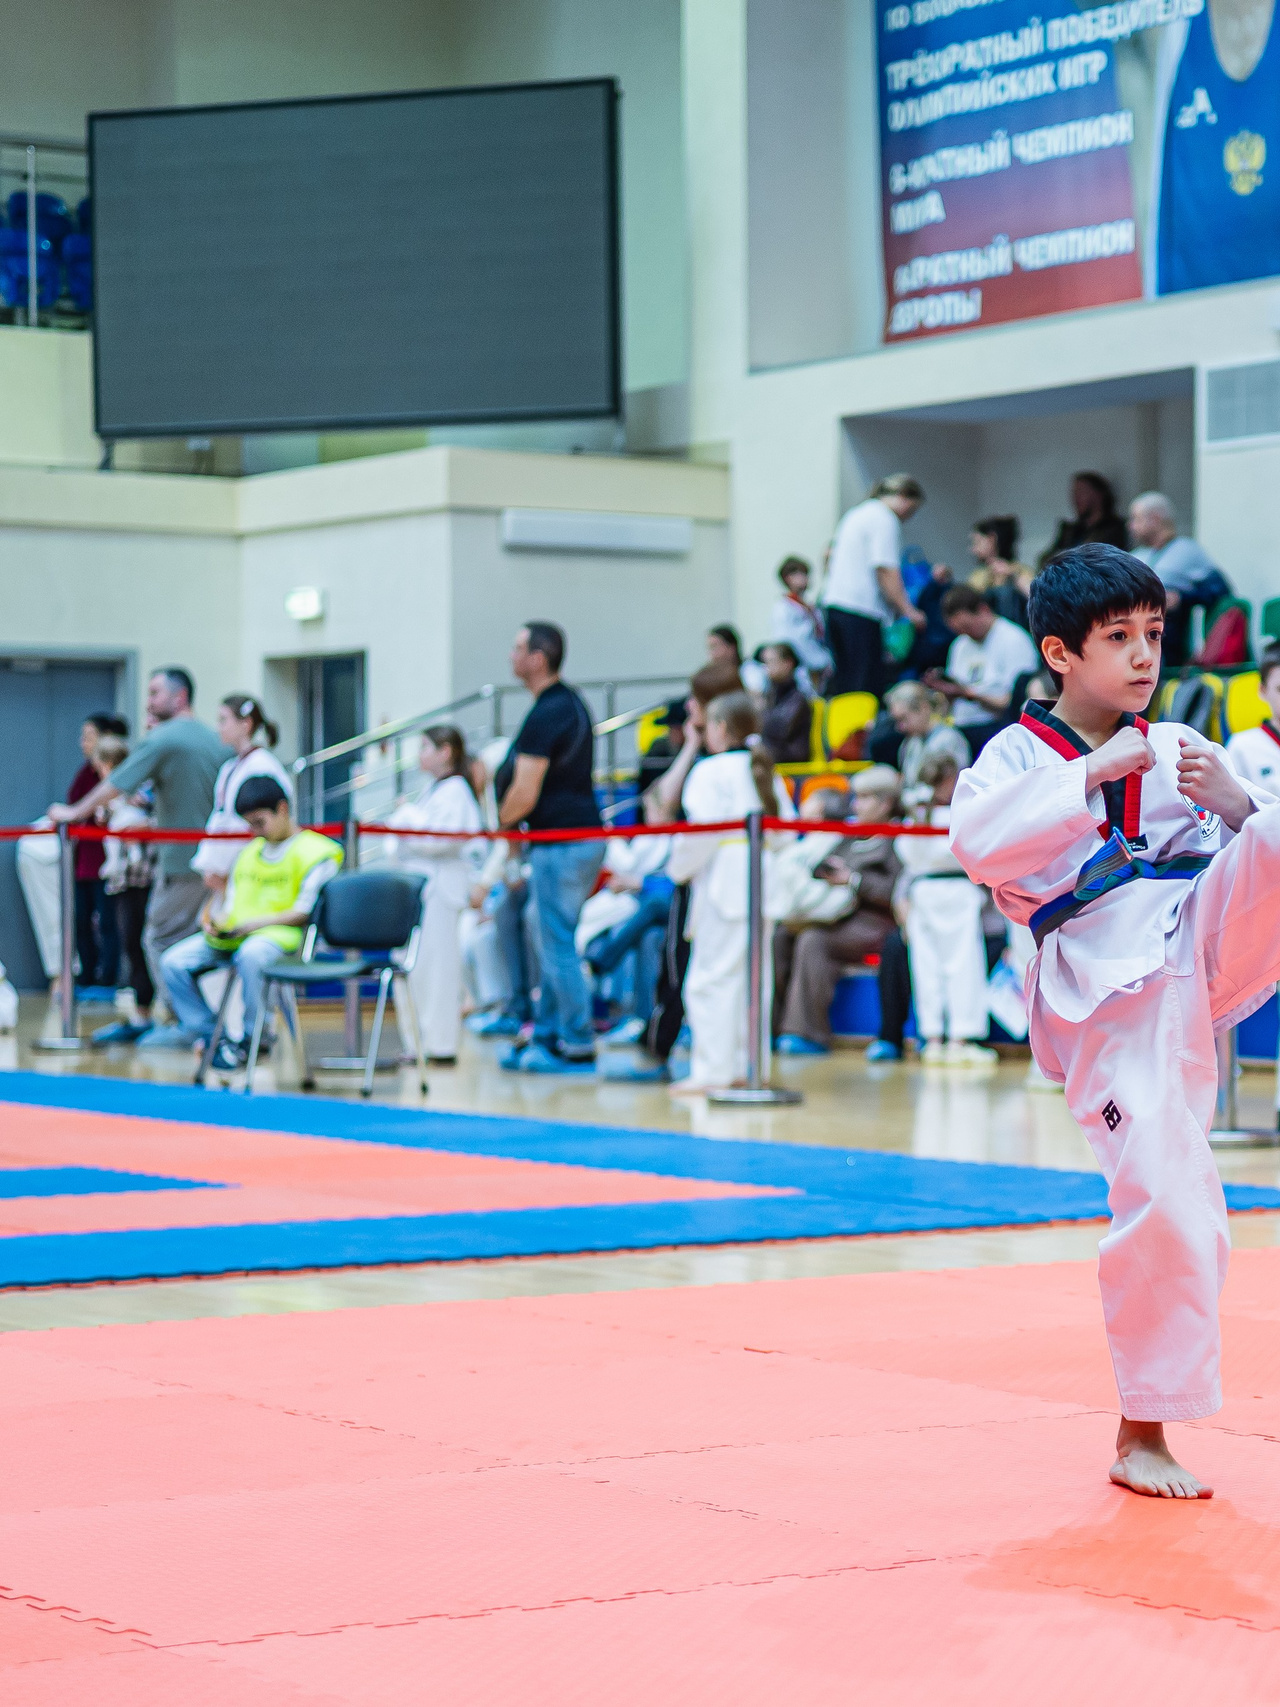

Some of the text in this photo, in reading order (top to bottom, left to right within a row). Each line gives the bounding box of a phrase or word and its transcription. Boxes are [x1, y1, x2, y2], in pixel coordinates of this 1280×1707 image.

[1057, 50, 1108, 89] ИГР
[1012, 109, 1134, 165] ЧЕМПИОН
[1014, 217, 1136, 272] ЧЕМПИОН
